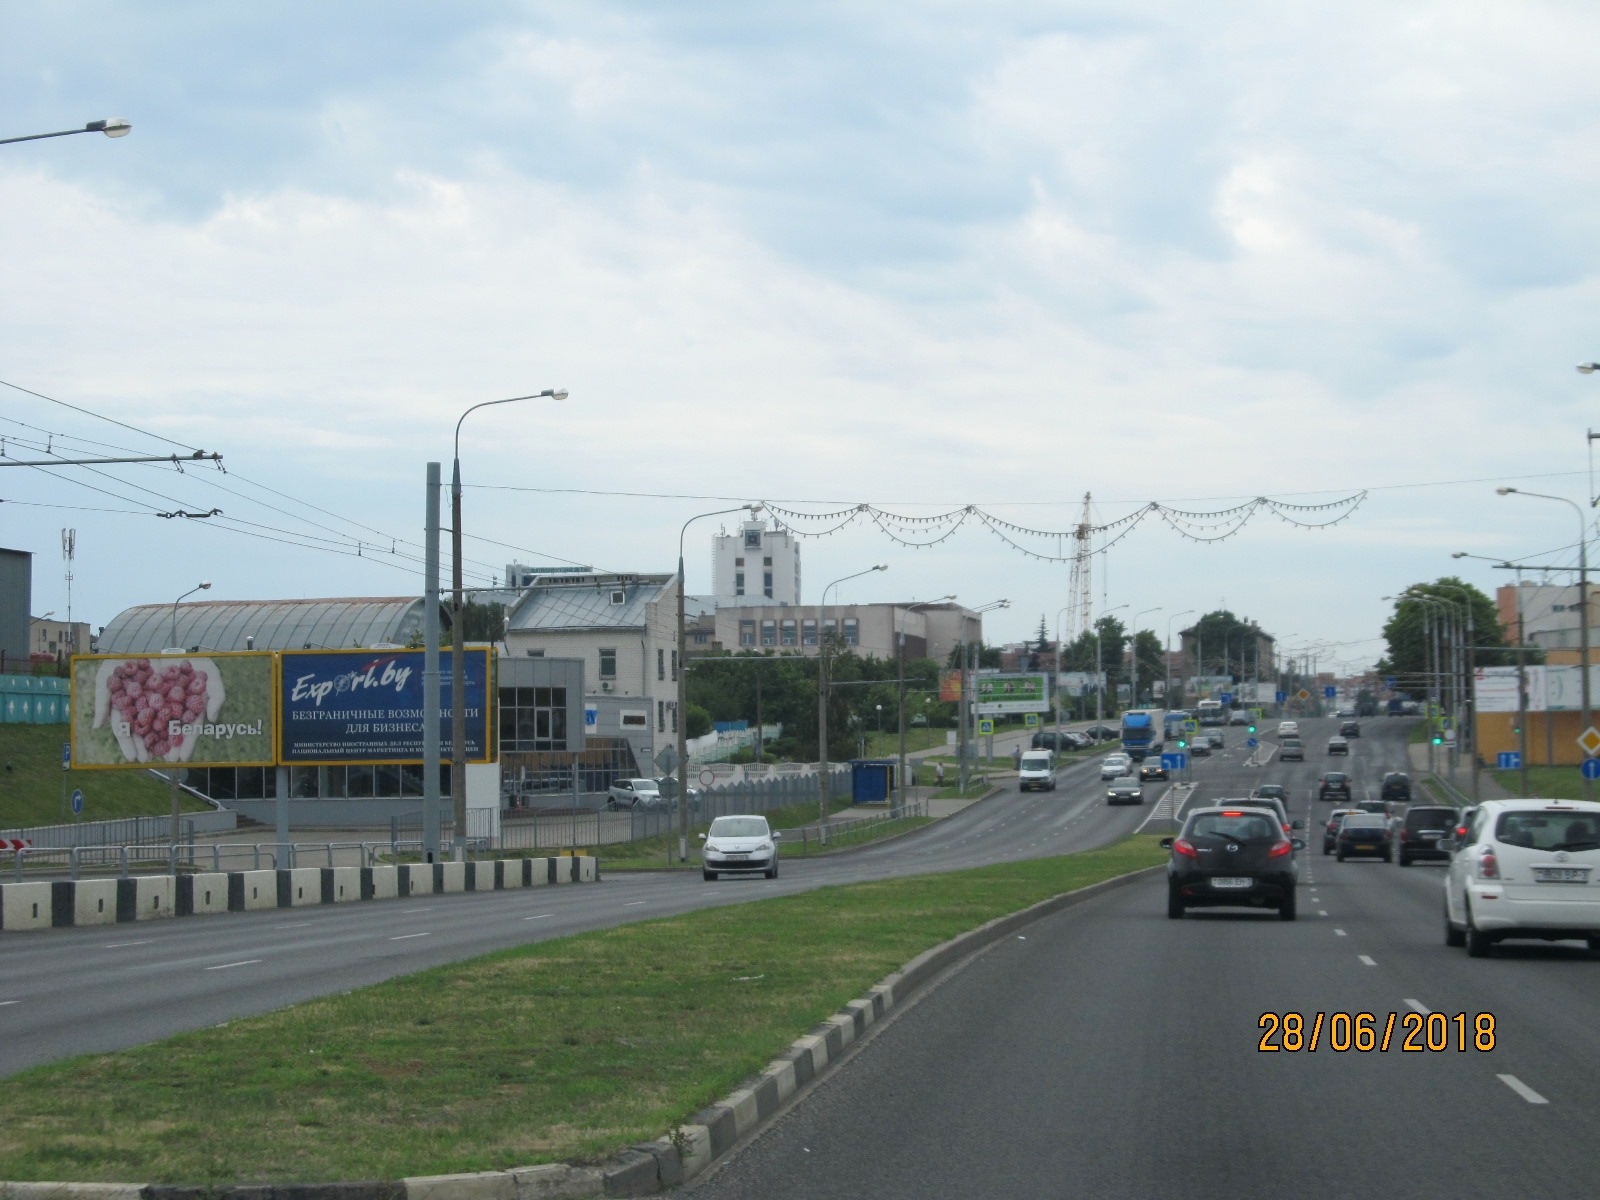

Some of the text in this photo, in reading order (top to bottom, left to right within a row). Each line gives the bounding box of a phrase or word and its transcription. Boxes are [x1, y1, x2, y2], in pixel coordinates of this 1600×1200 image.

[292, 709, 385, 720] БЕЗГРАНИЧНЫЕ
[119, 719, 262, 739] Я Беларусь!
[345, 723, 370, 735] ДЛЯ
